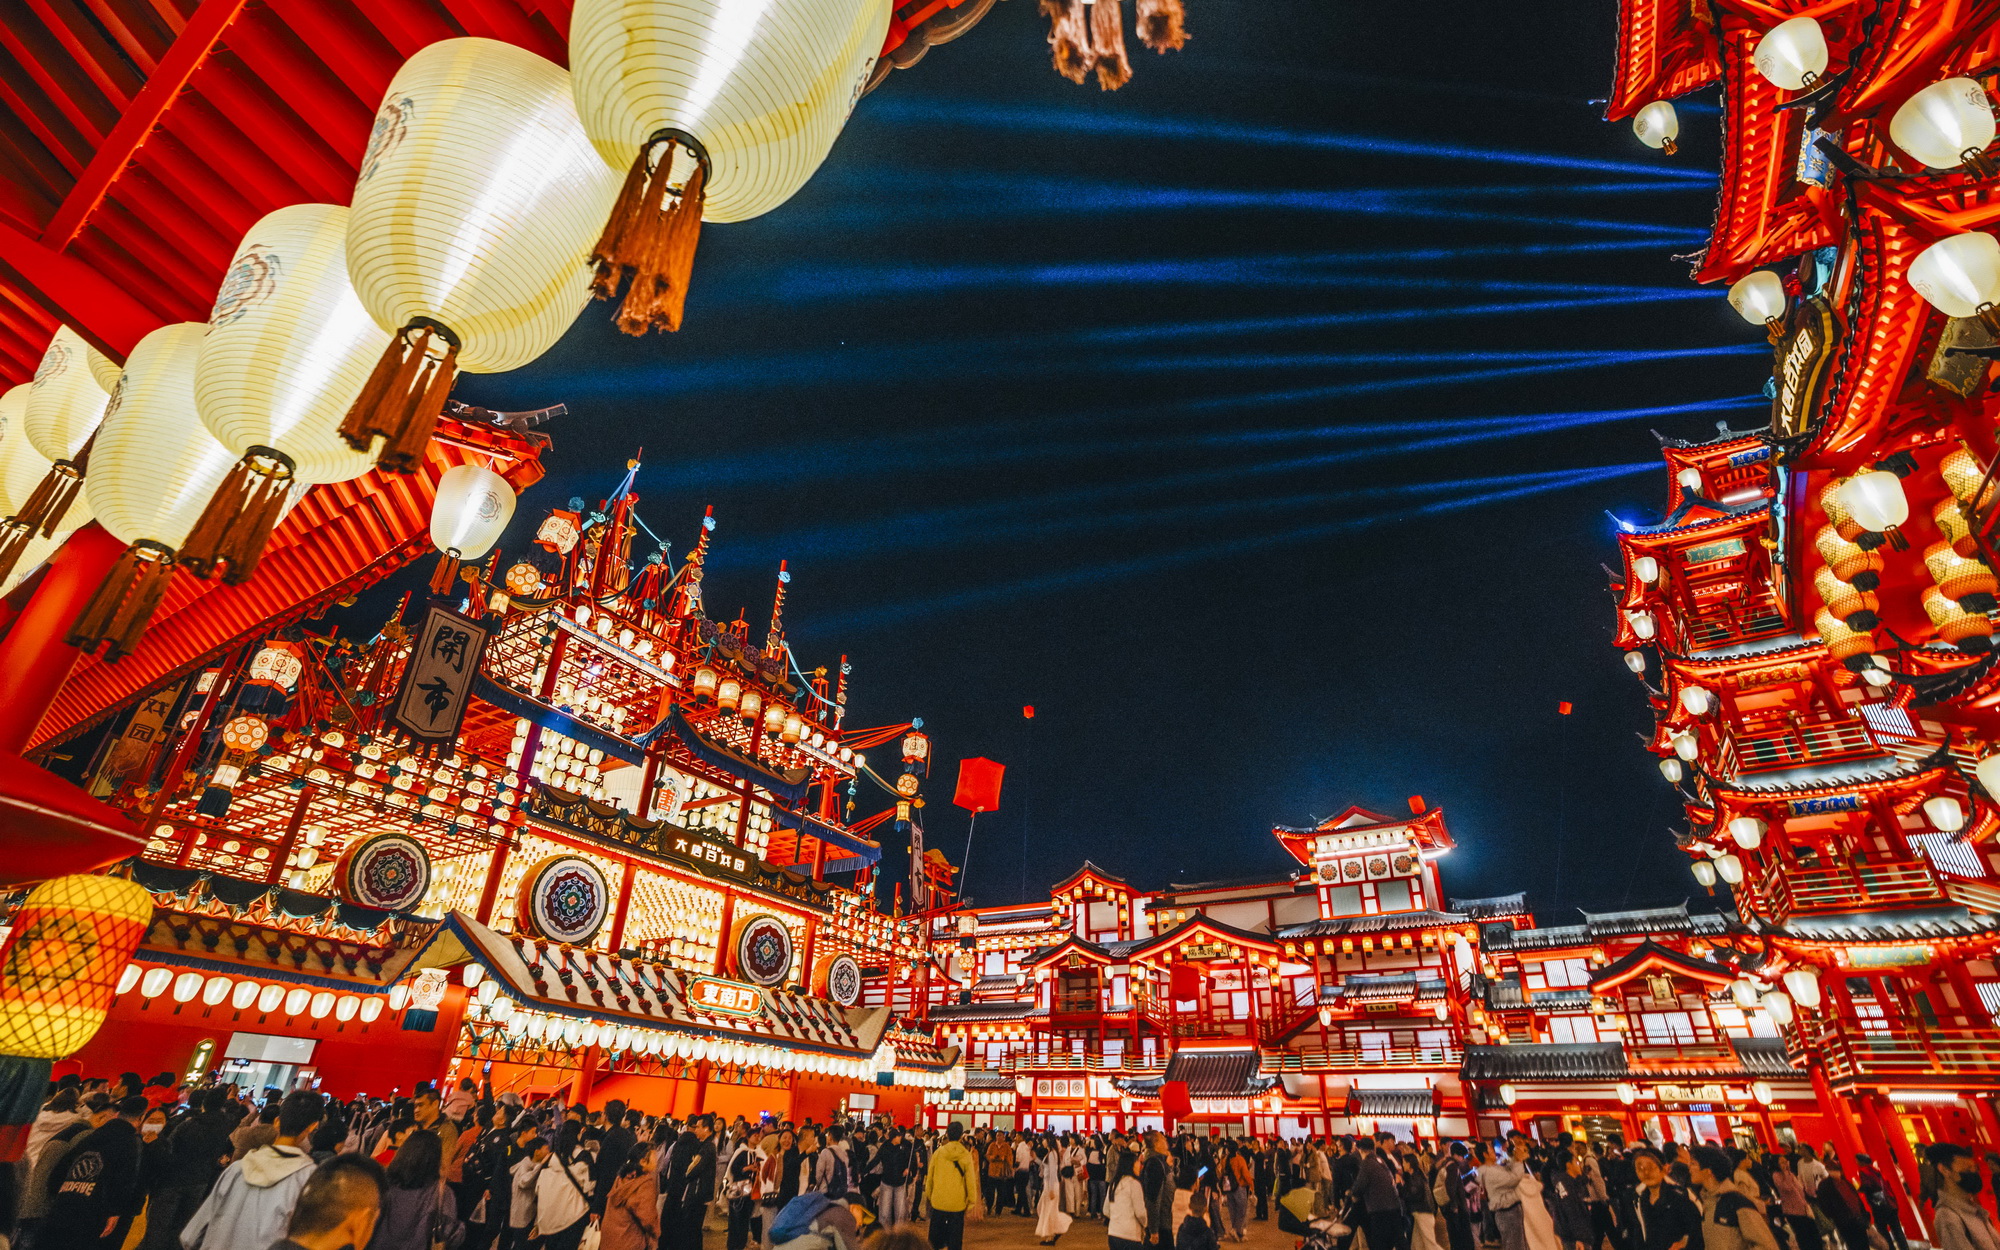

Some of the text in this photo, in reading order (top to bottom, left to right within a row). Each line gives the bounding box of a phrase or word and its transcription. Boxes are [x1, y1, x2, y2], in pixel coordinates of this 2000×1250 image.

[416, 625, 471, 727] 開市
[128, 685, 178, 743] 戏园
[675, 838, 745, 873] 大唐百戏园
[700, 984, 754, 1011] 東南門
